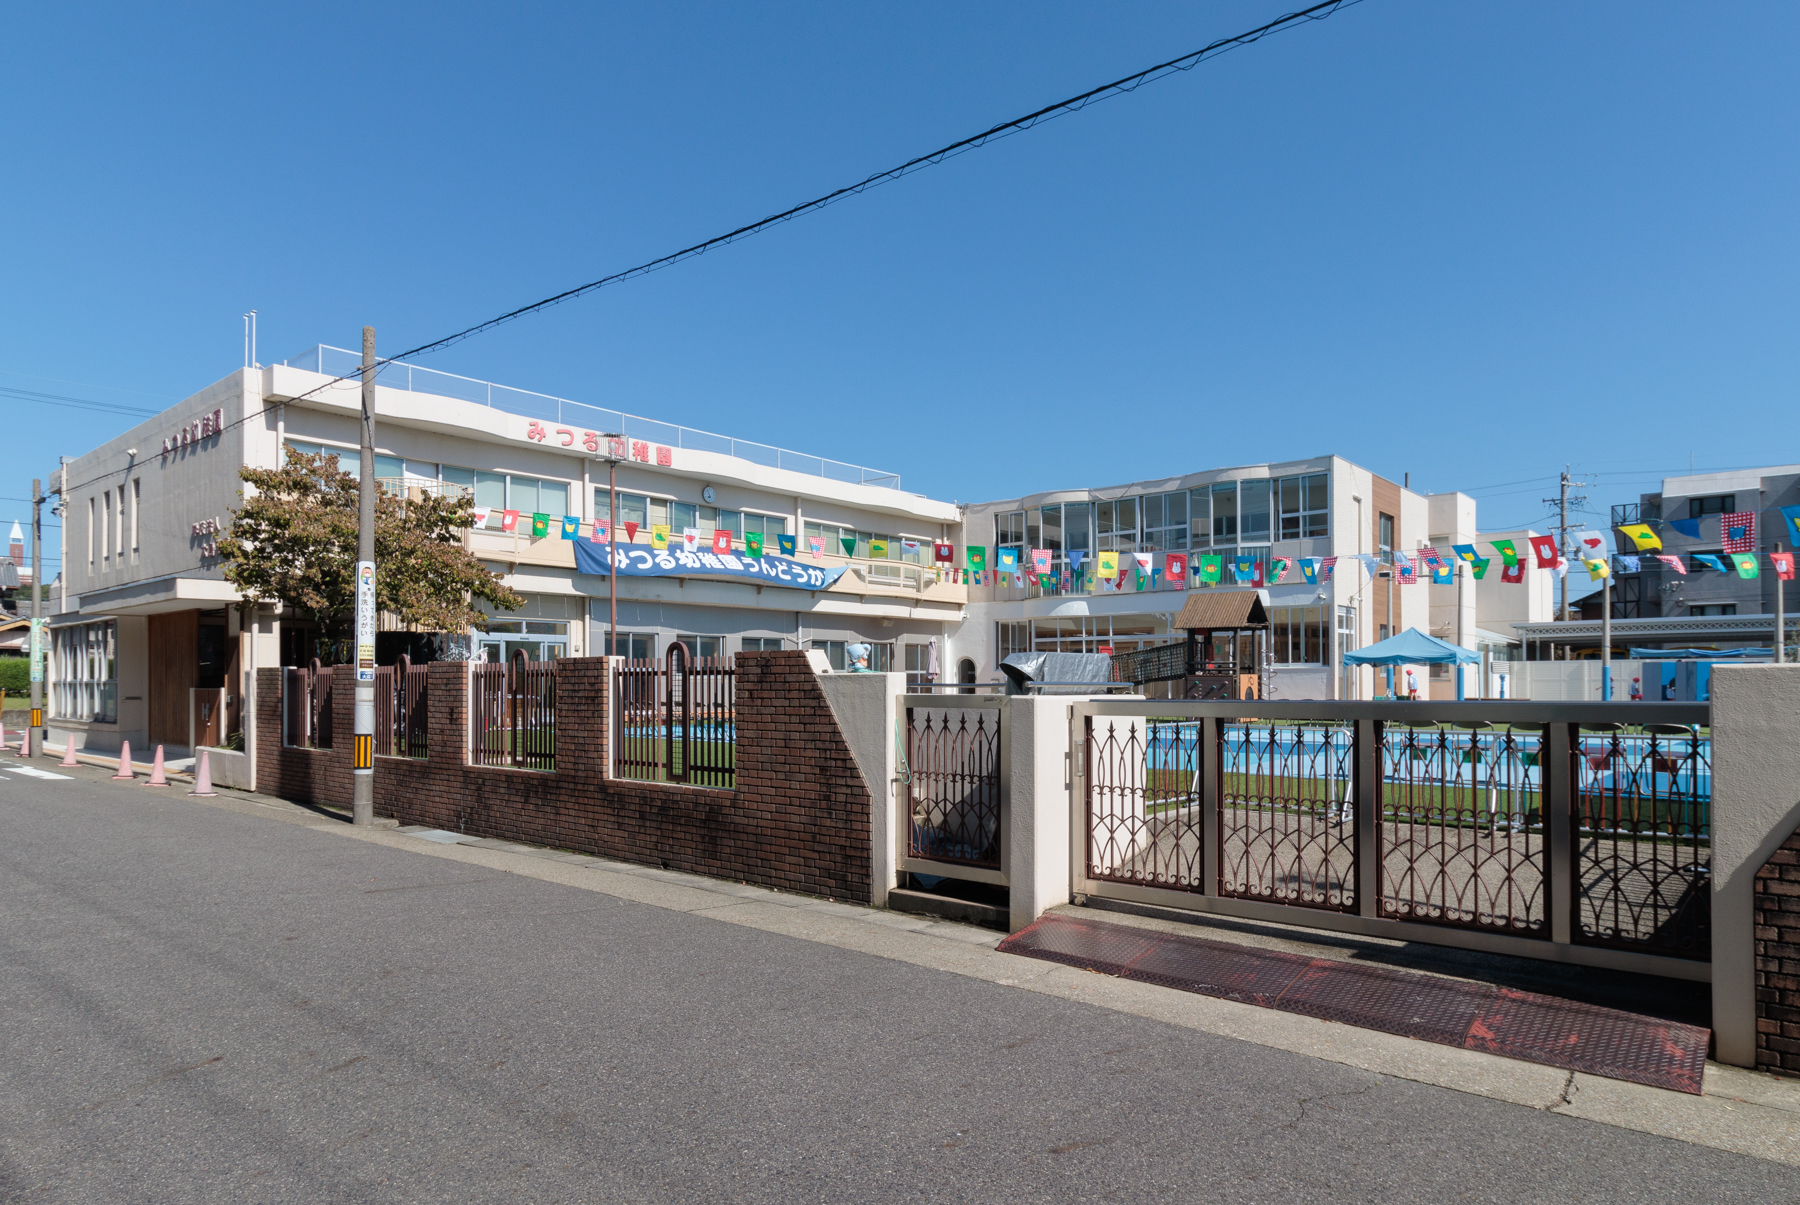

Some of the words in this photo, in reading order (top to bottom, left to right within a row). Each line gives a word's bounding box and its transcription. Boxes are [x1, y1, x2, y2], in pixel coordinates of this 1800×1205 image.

[527, 421, 673, 467] みつる幼稚園
[605, 546, 826, 586] みつる幼稚園うんどうか
[360, 591, 369, 637] 手洗いうがい
